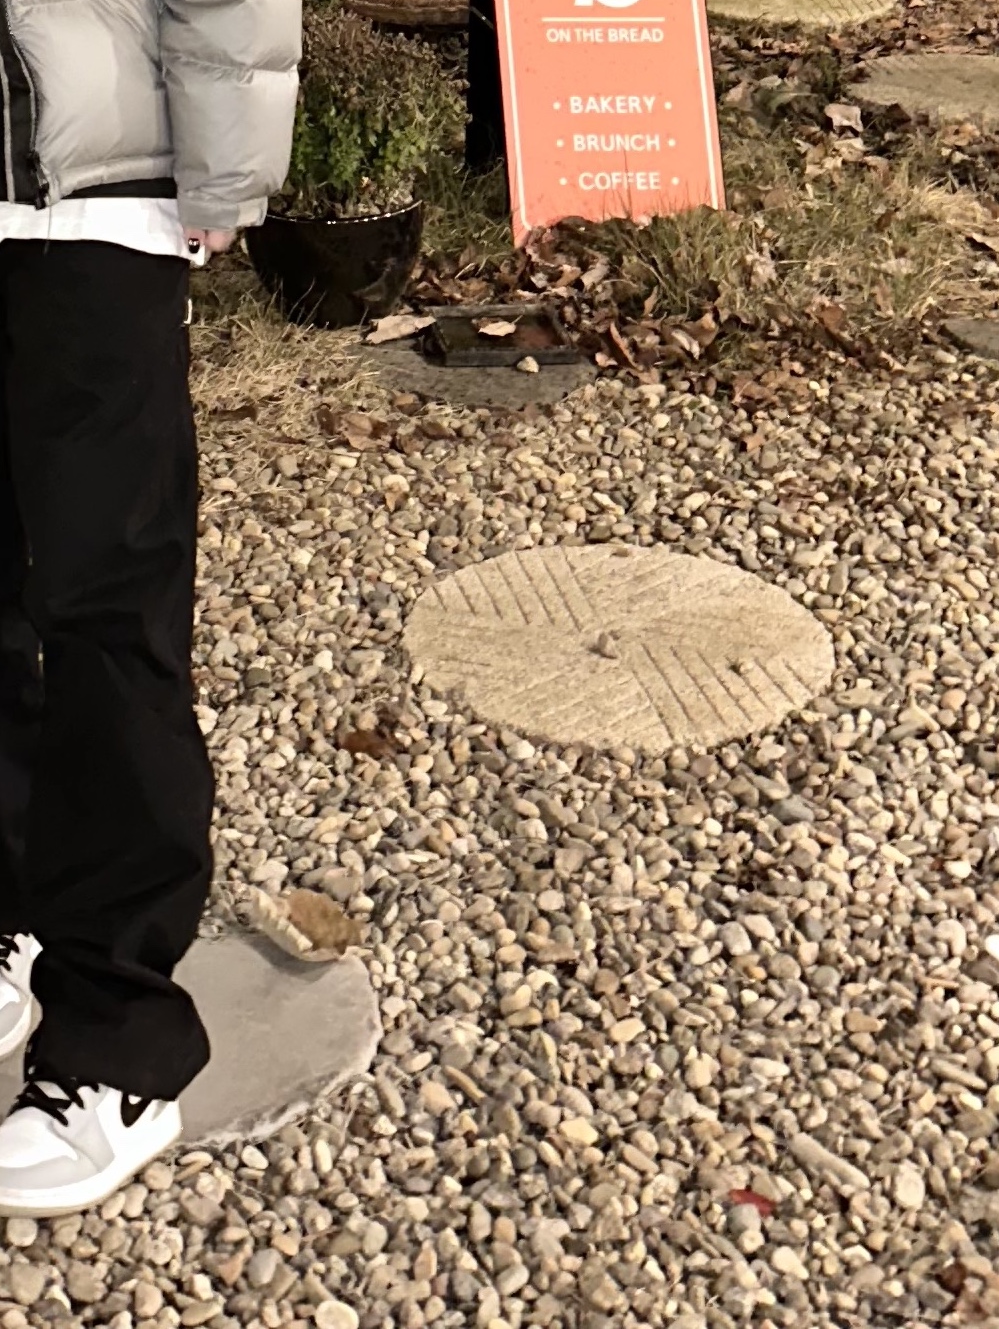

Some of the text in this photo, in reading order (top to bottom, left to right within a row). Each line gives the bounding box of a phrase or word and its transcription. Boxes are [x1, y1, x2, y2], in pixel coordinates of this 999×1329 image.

[546, 27, 665, 43] ON THE BREAD
[569, 95, 656, 114] BAKERY
[573, 133, 661, 152] BRUNCH
[578, 171, 661, 191] COFFEE
